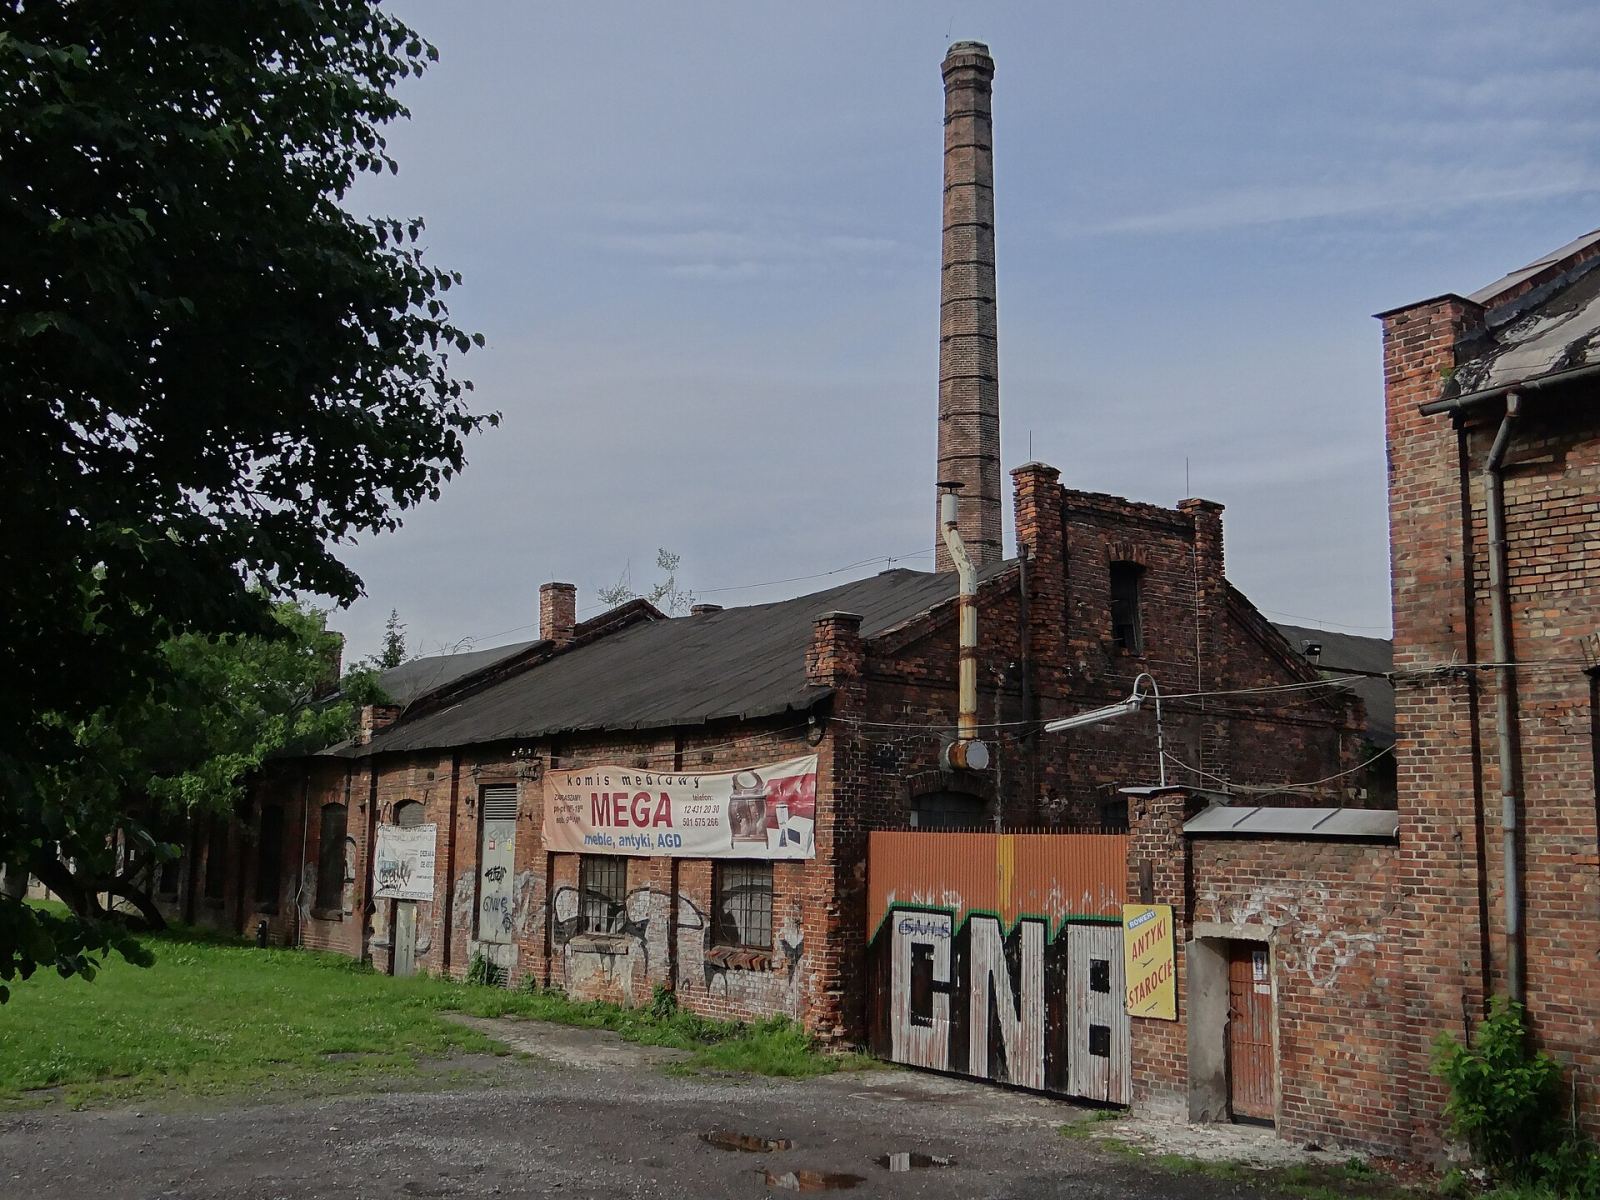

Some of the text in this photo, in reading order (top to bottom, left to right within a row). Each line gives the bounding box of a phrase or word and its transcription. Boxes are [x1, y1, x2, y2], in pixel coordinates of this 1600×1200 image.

[567, 773, 610, 786] komis
[591, 792, 673, 828] MEGA
[683, 804, 720, 814] 12 431 20 30
[682, 817, 694, 828] 501
[584, 833, 682, 851] meble, antyki, AGD
[1131, 917, 1167, 962] ANTYKI
[1129, 958, 1173, 1009] STAROCIE
